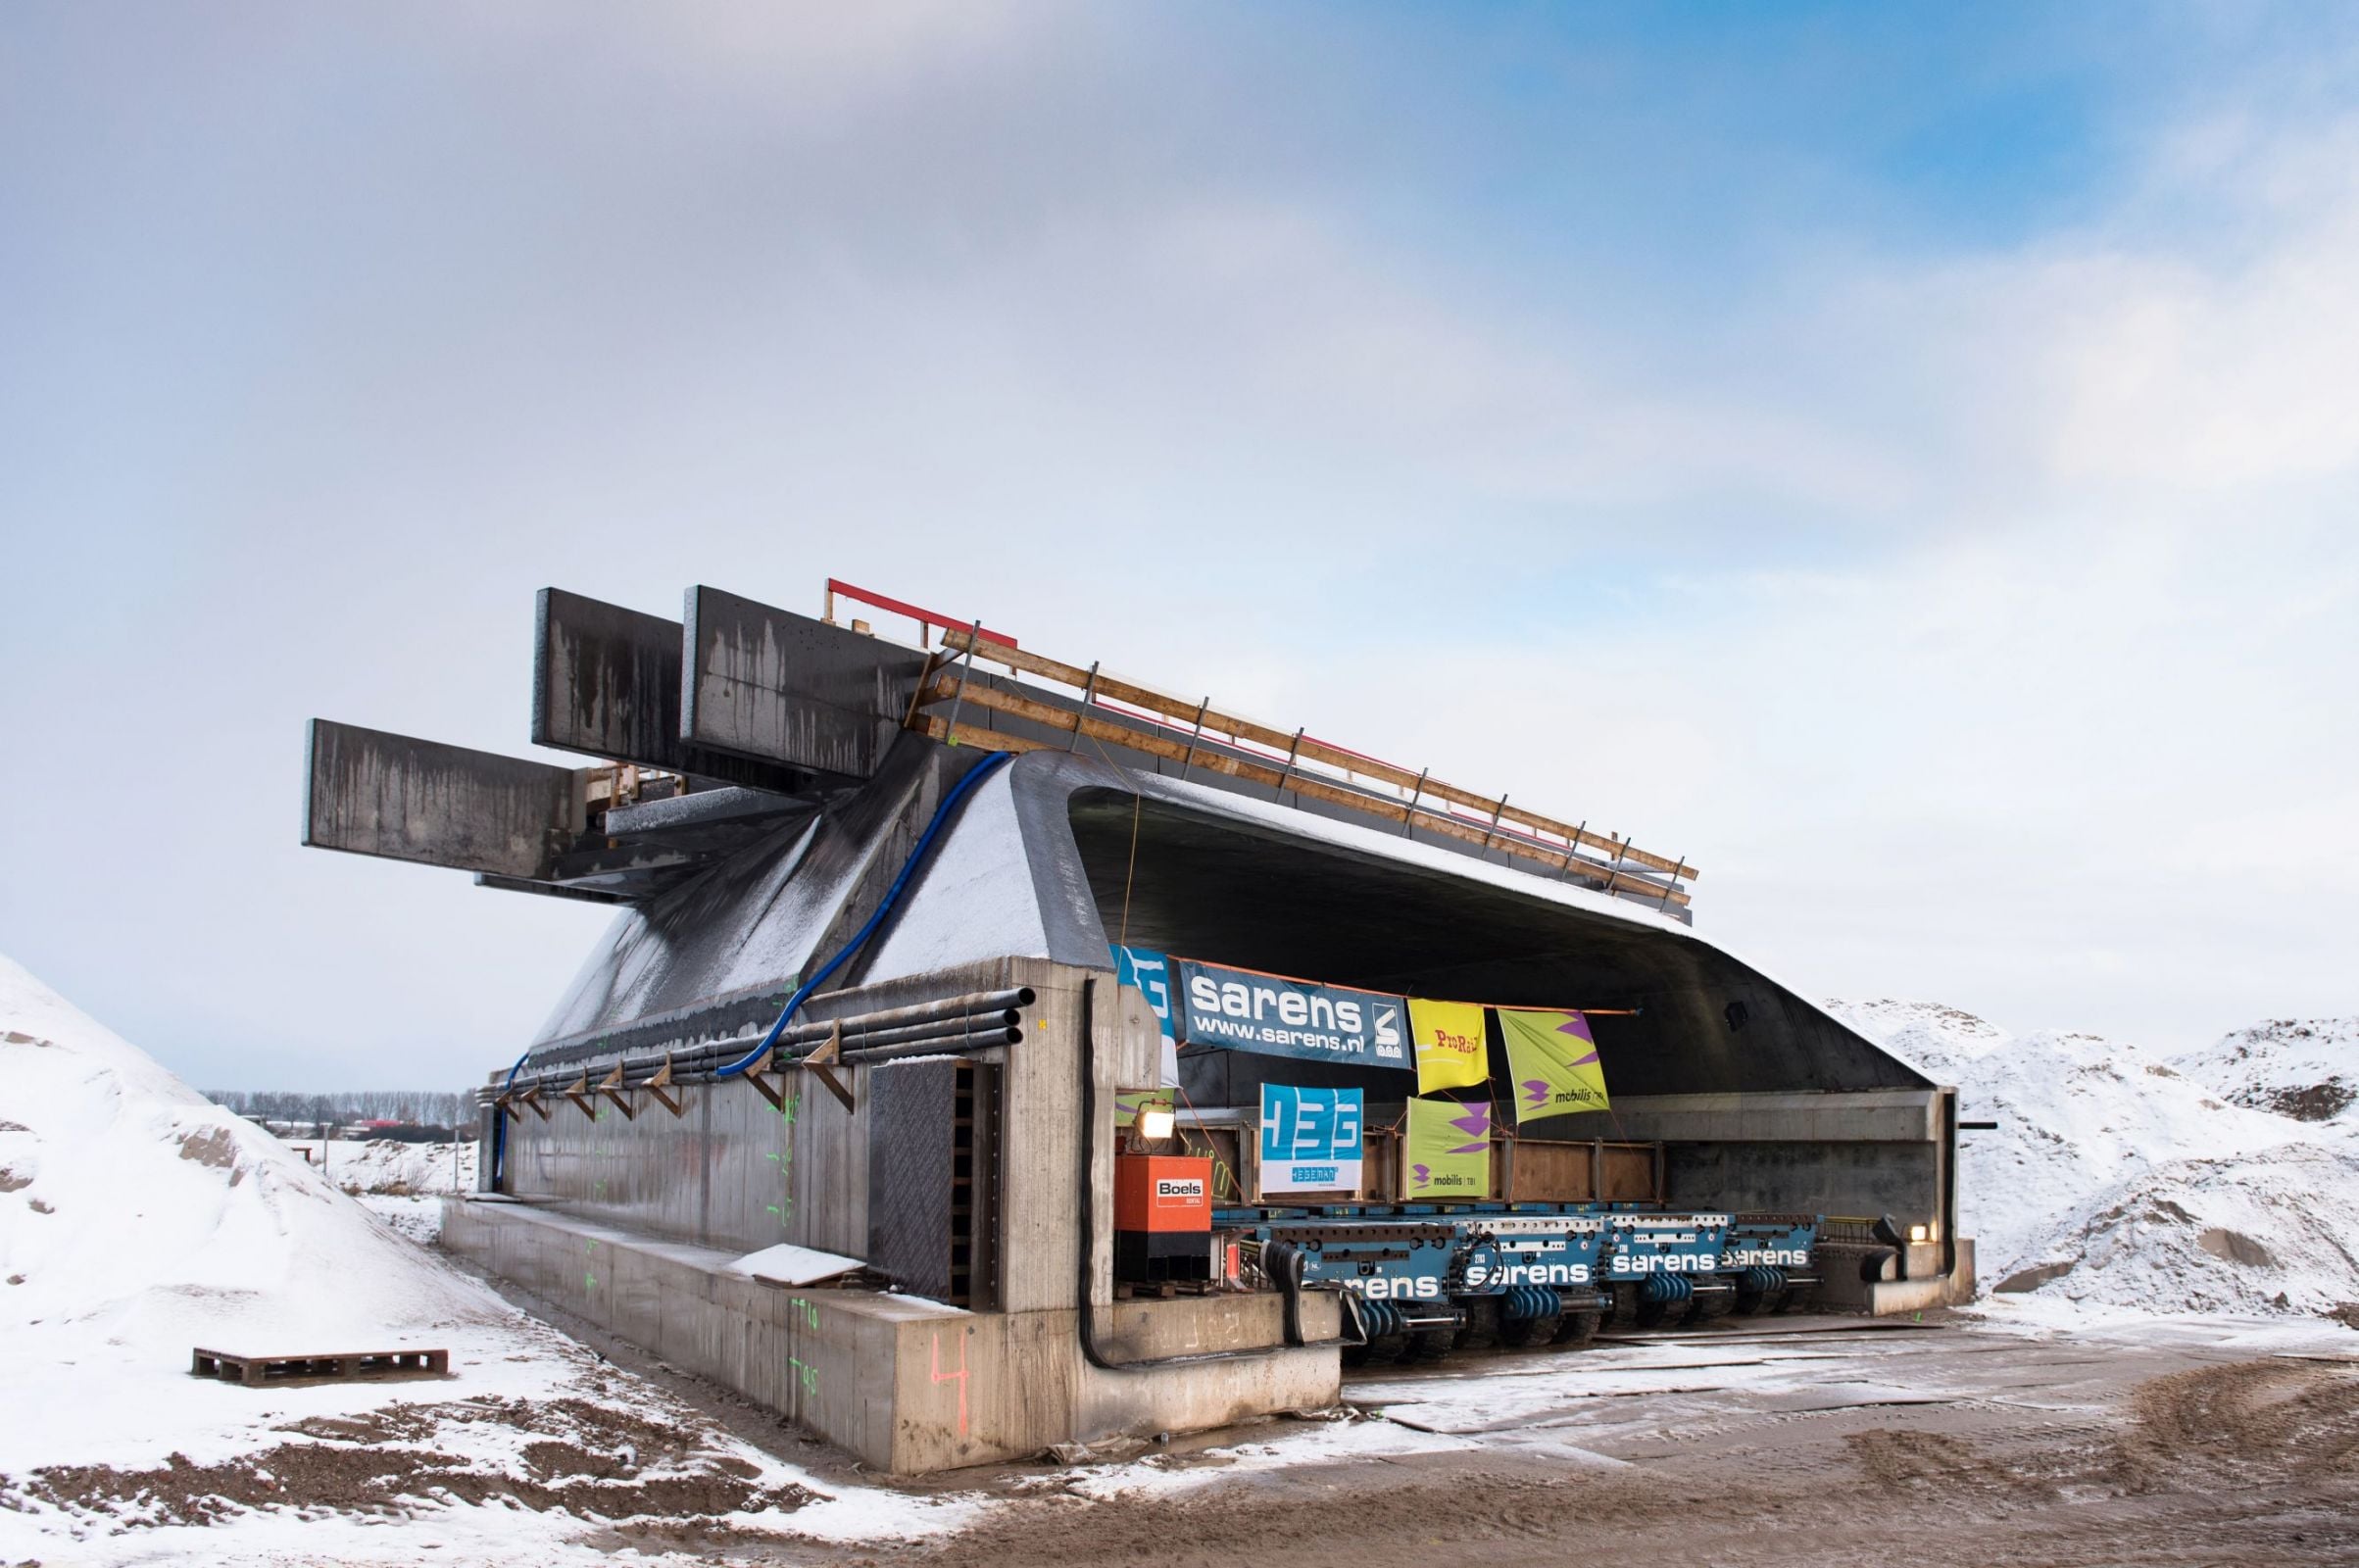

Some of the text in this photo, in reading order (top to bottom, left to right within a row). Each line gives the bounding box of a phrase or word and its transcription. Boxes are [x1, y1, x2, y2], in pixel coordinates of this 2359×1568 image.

[1191, 975, 1362, 1033] sarens
[1194, 1015, 1364, 1054] www.sarens.nl
[1555, 1088, 1591, 1102] mobilis
[1159, 1182, 1201, 1195] Boels
[1434, 1174, 1462, 1186] mobilis
[1612, 1252, 1715, 1273] sarens
[1721, 1249, 1807, 1265] sarens
[1466, 1262, 1589, 1286] sarens
